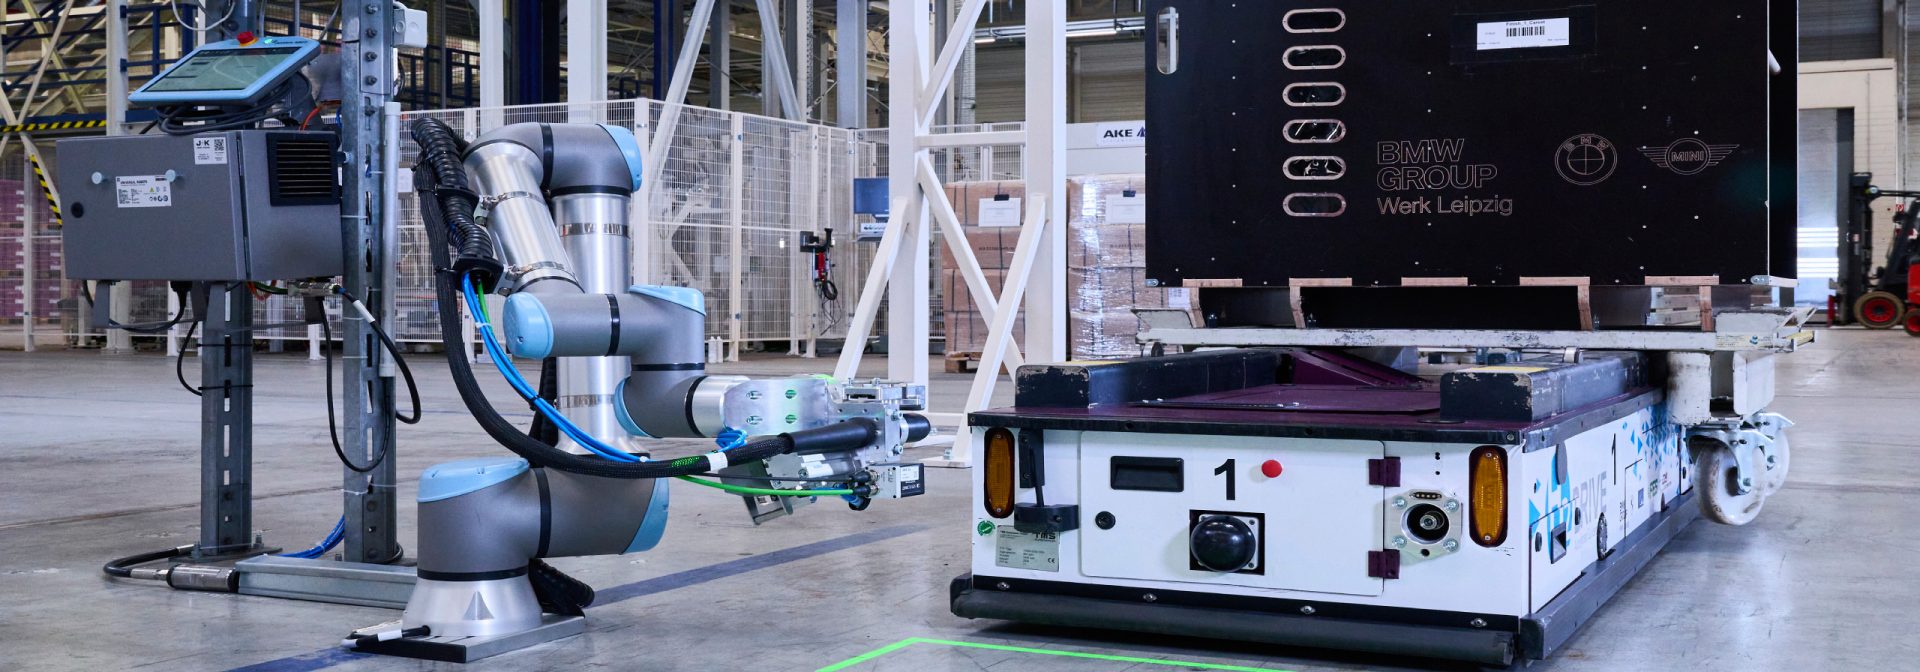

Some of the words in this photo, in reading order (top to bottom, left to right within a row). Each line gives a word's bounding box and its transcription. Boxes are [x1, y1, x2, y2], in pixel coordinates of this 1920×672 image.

[1103, 129, 1133, 138] AKE
[1377, 139, 1464, 165] BMW
[1671, 150, 1705, 163] MINI
[1376, 164, 1498, 191] GROUP
[1377, 196, 1432, 215] Werk
[1437, 194, 1513, 216] Leipzig
[1612, 433, 1616, 485] 1
[1214, 458, 1236, 501] 1
